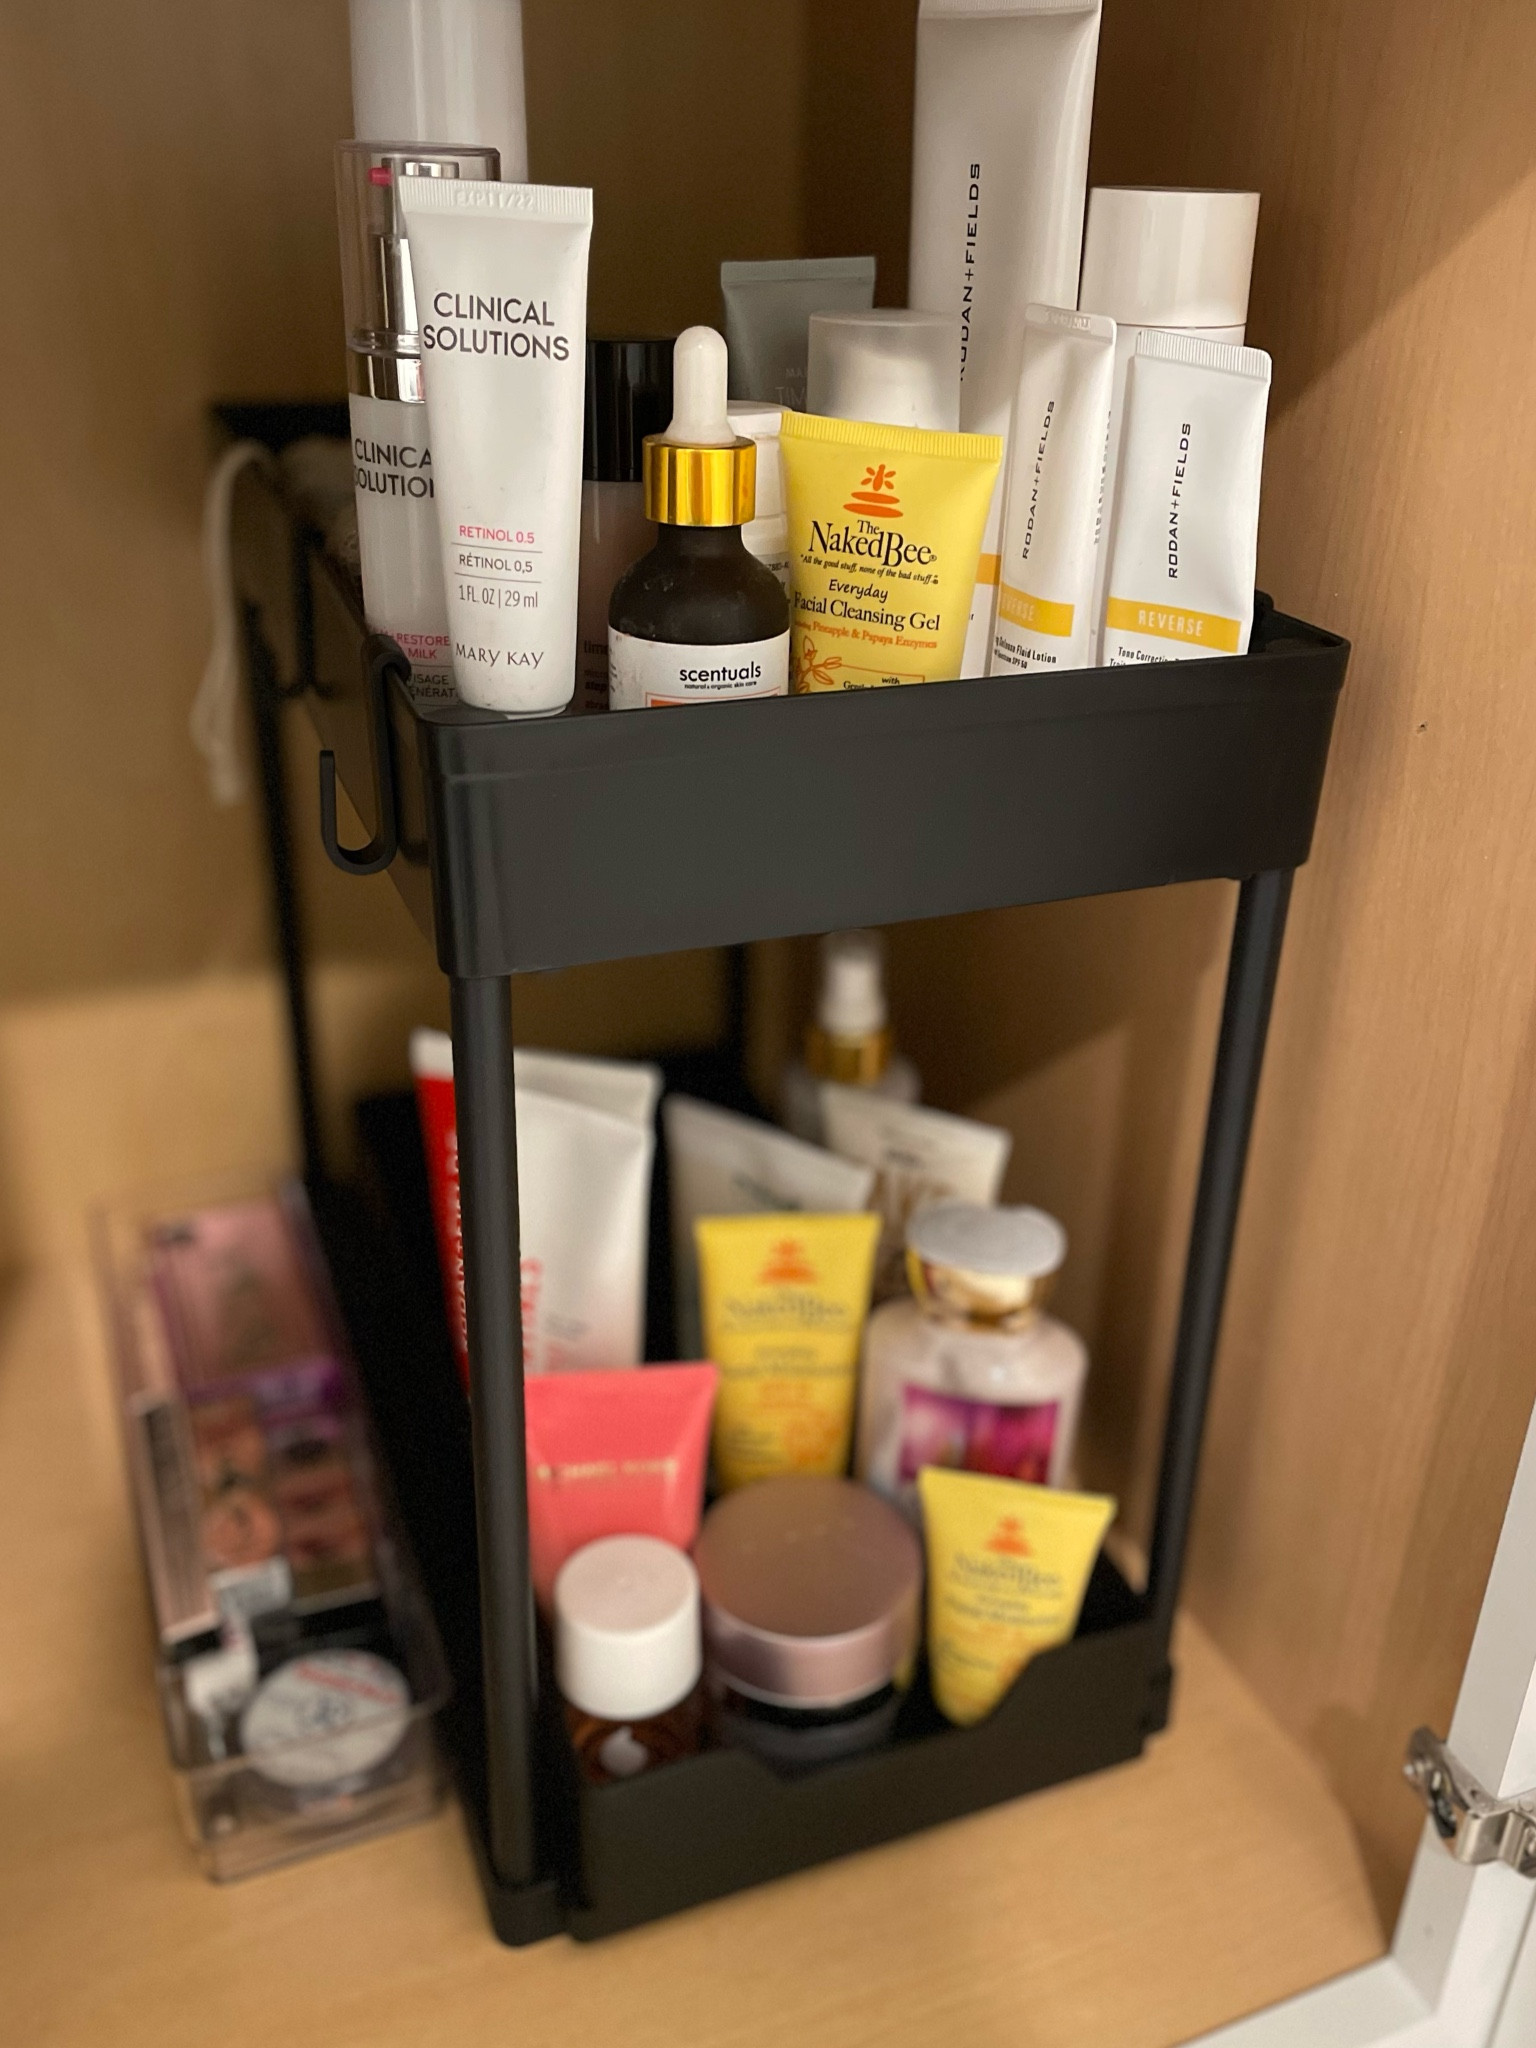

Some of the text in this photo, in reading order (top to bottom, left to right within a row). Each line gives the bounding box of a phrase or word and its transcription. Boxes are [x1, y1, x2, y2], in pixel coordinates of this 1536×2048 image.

[433, 292, 555, 327] CLINICAL
[423, 324, 569, 361] SOLUTIONS
[355, 438, 432, 469] CLINICA
[1022, 400, 1055, 560] RODAN+FIELDS
[1167, 423, 1192, 579] RODAN+FIELDS
[459, 525, 535, 544] RETINOL 0.5
[857, 519, 880, 535] The
[459, 552, 533, 574] RÉTINOL 0,5
[482, 587, 495, 605] OZ
[504, 590, 520, 607] 29
[523, 591, 538, 608] ml
[828, 578, 889, 603] Everyday
[794, 591, 827, 614] Facial
[830, 599, 906, 632] Cleansing
[909, 611, 941, 631] Gel
[1138, 609, 1204, 637] REVERSE
[408, 648, 437, 659] MILK
[456, 642, 544, 669] MARY KAY
[1032, 650, 1057, 664] Lotion
[409, 673, 449, 685] ISAGE
[679, 661, 761, 682] scentuals
